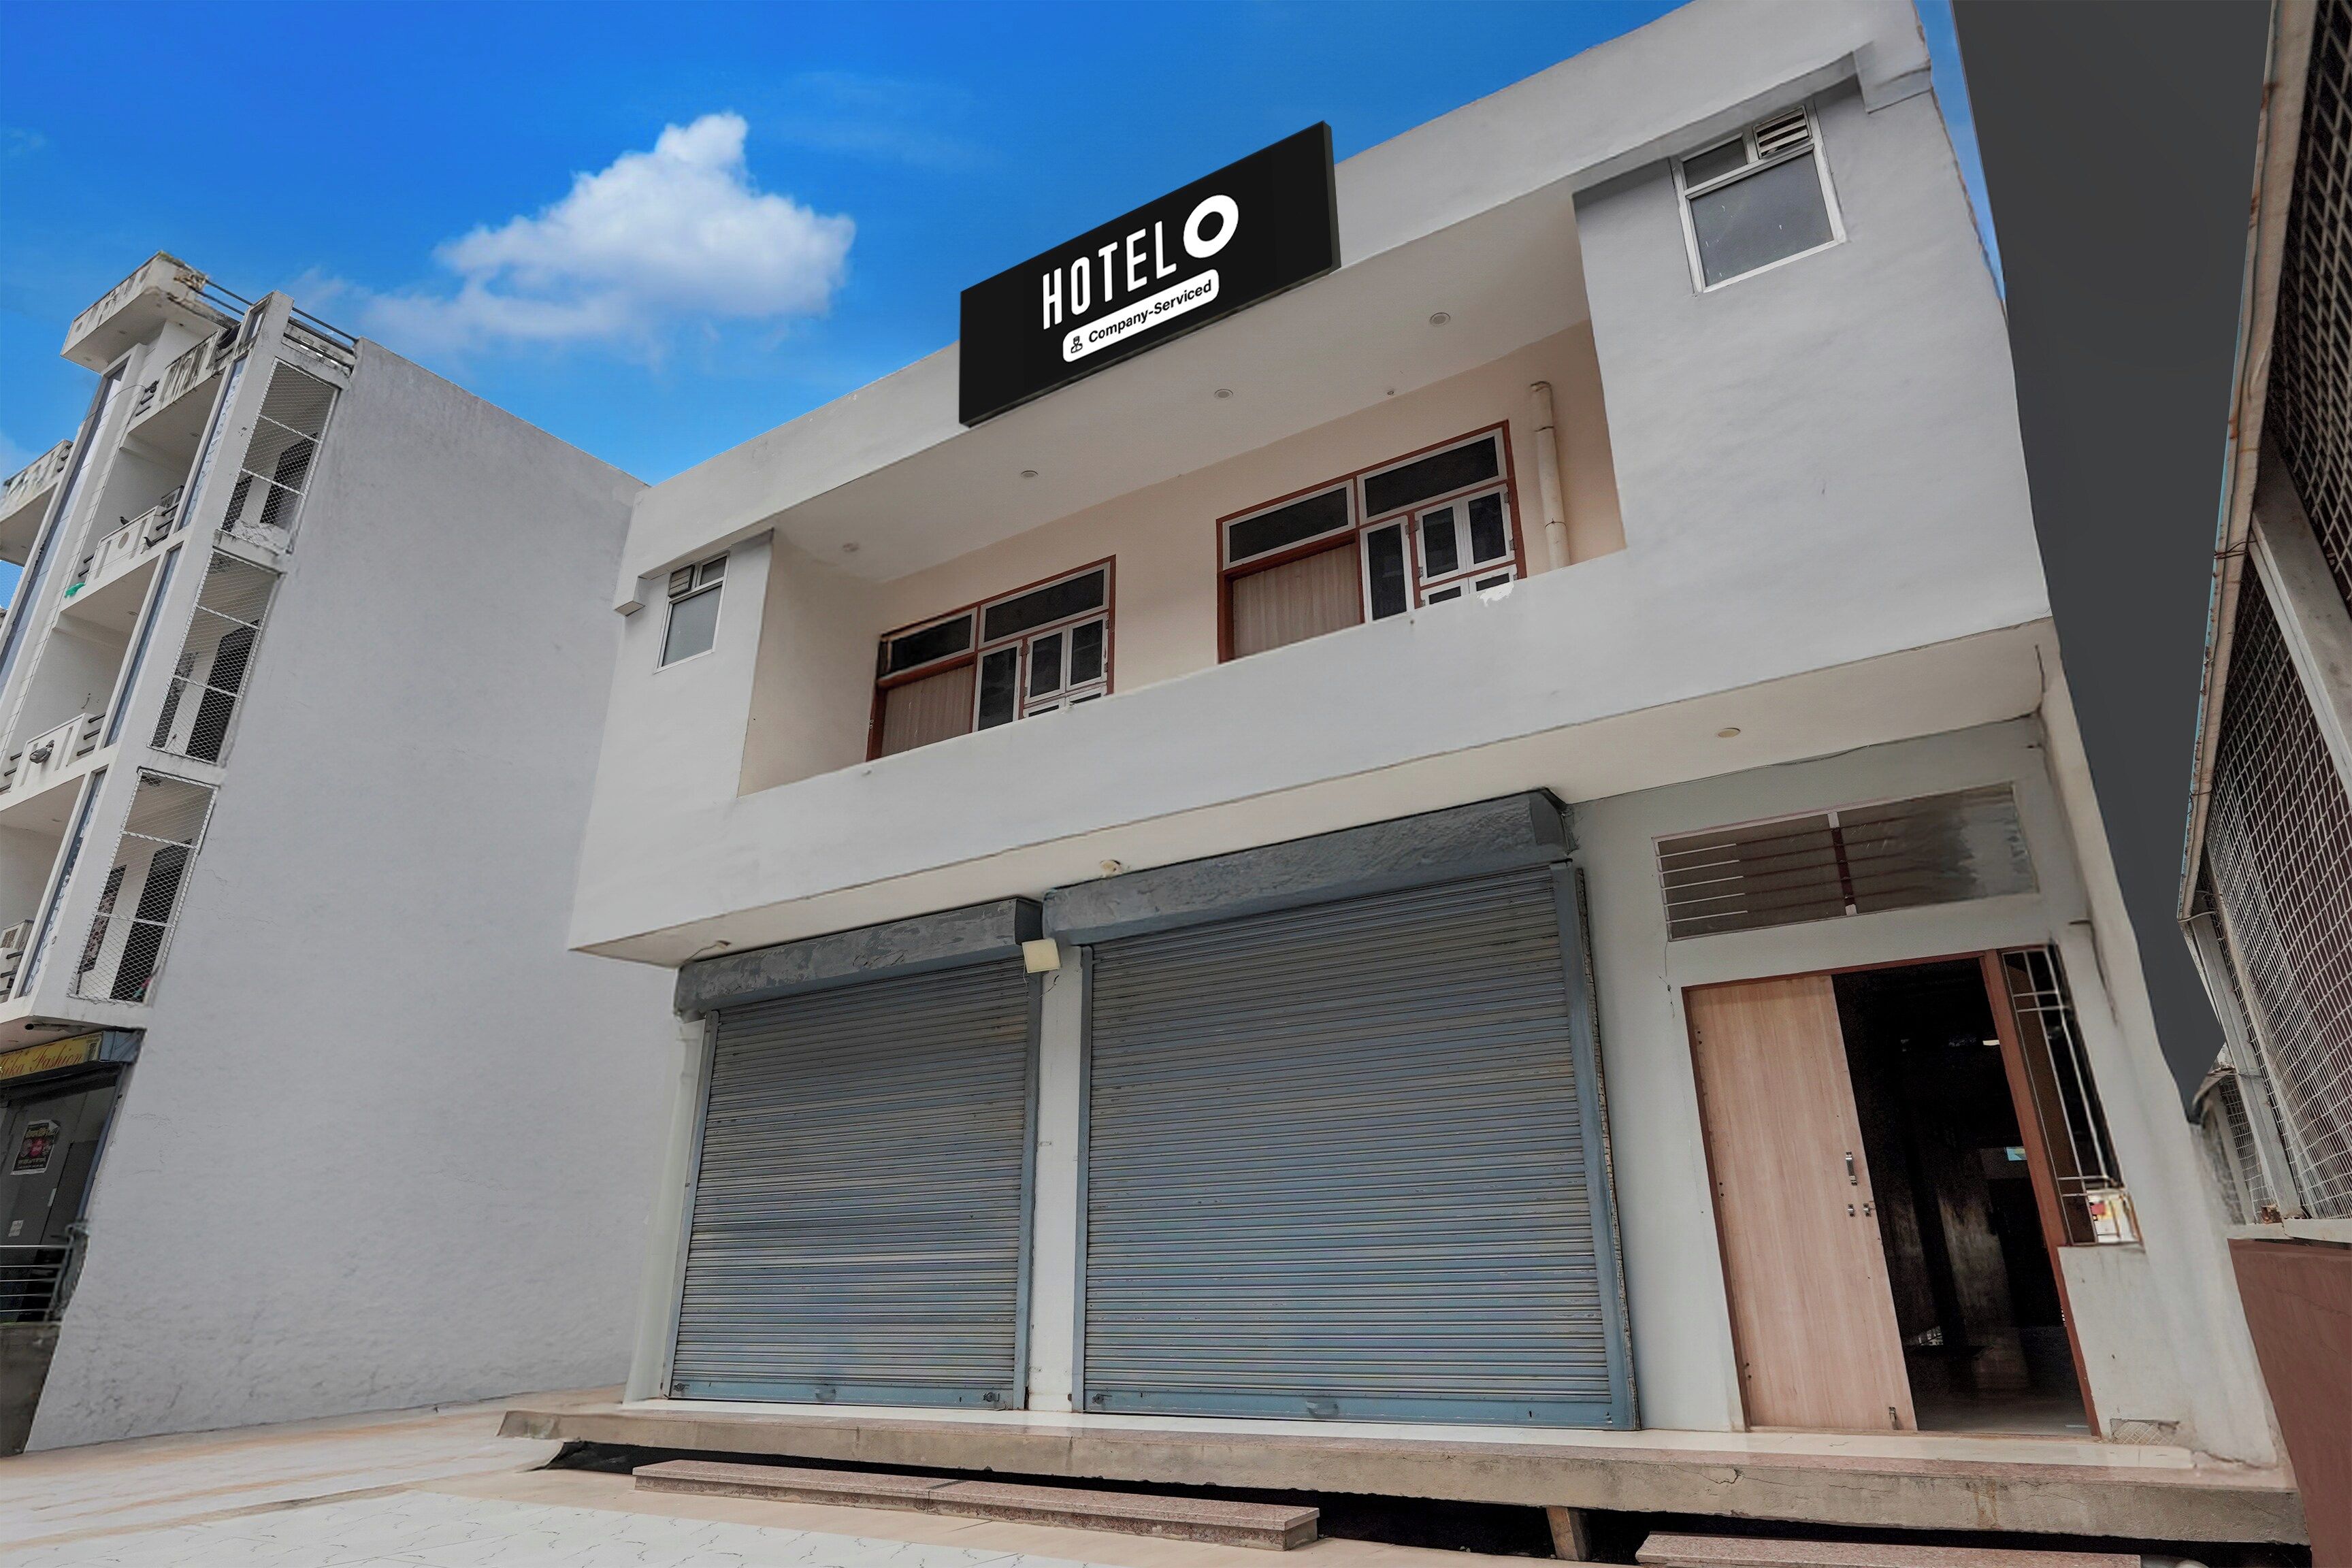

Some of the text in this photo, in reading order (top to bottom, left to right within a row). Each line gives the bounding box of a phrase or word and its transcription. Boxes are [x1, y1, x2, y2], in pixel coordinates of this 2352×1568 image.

[1043, 220, 1177, 330] HOTEL
[1088, 279, 1211, 343] Company-Serviced
[29, 1043, 82, 1072] Fashion
